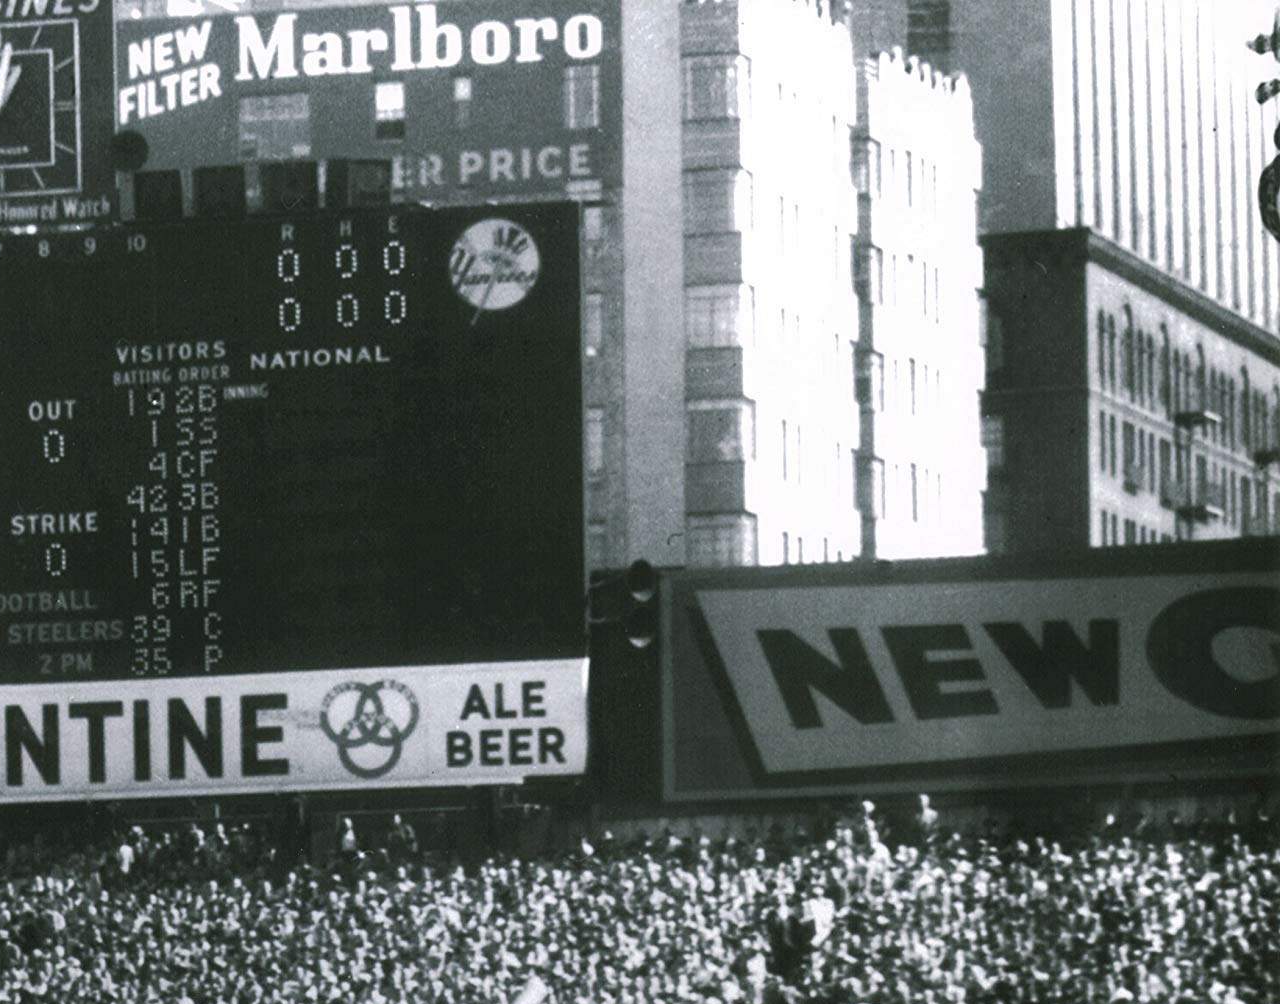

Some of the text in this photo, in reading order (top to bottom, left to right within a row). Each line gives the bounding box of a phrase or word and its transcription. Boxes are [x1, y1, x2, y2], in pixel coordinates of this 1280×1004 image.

[128, 21, 212, 79] NEW
[234, 6, 603, 81] Marlboro
[119, 63, 221, 125] FILTER
[459, 143, 591, 185] PRICE
[62, 197, 110, 218] Watch
[281, 216, 398, 240] R H E
[278, 249, 299, 282] 0
[383, 241, 405, 275] 0
[279, 291, 406, 332] 0 0 0
[116, 341, 226, 364] VISITORS
[250, 346, 390, 370] NATIONAL
[113, 365, 230, 386] BATTING ORDER
[224, 383, 269, 400] INNING
[28, 399, 75, 421] OUT
[44, 430, 65, 463] 0
[11, 512, 98, 536] STRIKE
[46, 543, 66, 576] 0
[8, 620, 123, 645] STEELERS
[40, 653, 93, 674] 2 PM
[756, 619, 1120, 730] NEW
[461, 681, 546, 721] ALE
[446, 727, 566, 768] BEER
